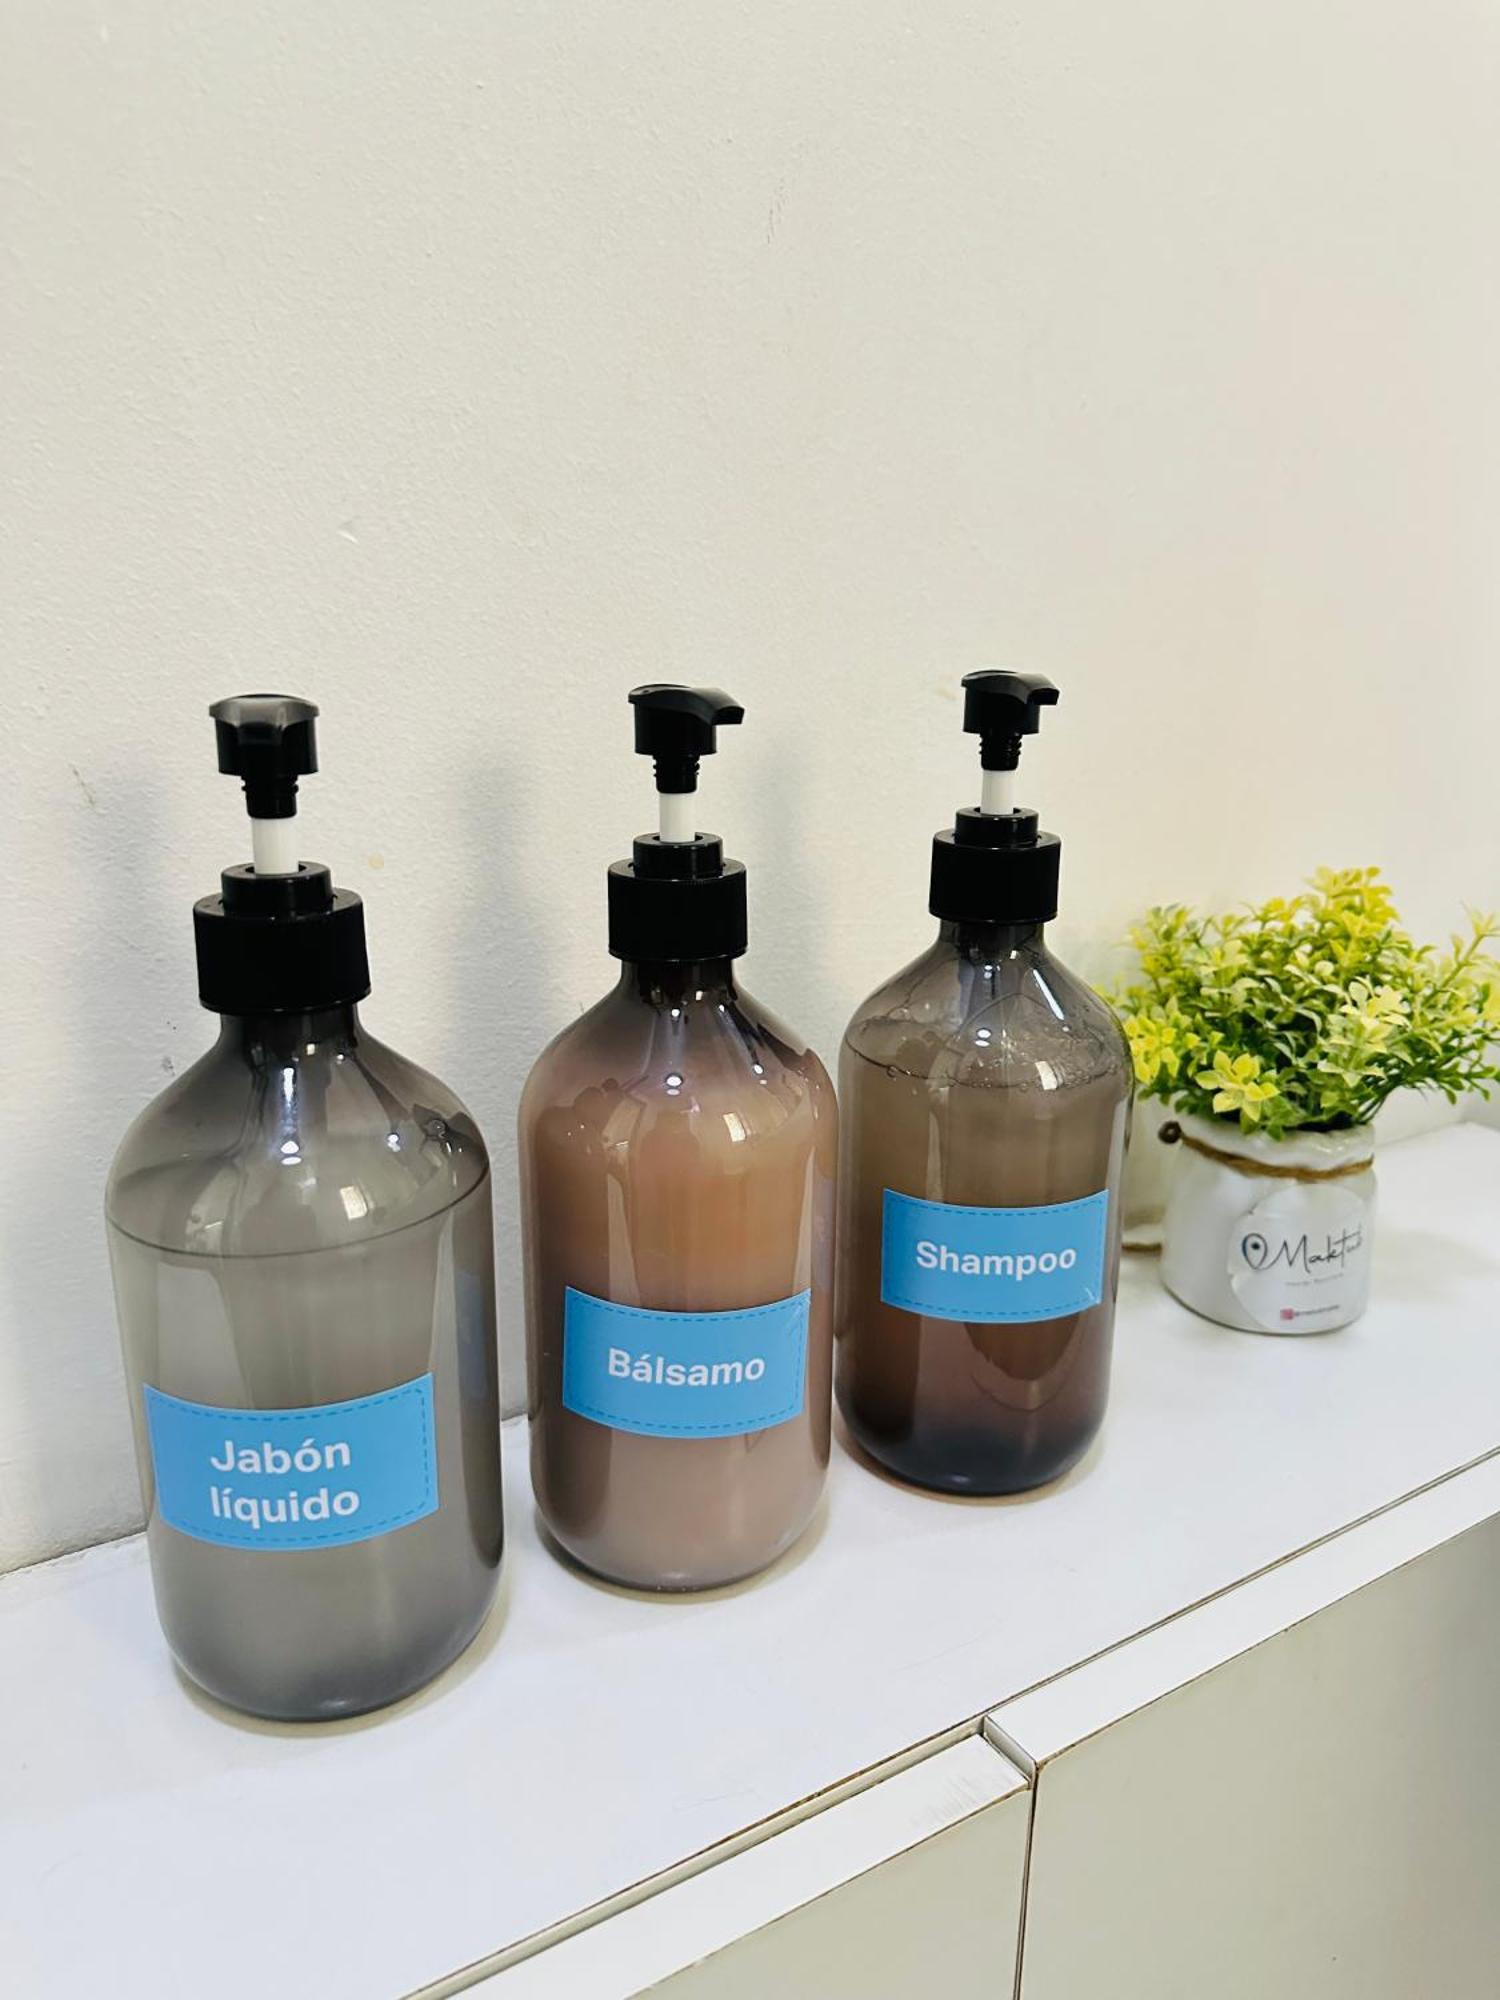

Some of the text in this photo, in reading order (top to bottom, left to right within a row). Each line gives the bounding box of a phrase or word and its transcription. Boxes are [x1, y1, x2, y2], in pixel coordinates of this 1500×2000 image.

[916, 1241, 1077, 1281] Shampoo
[608, 1348, 766, 1387] Bálsamo
[210, 1438, 351, 1474] Jabón
[210, 1486, 360, 1530] líquido
